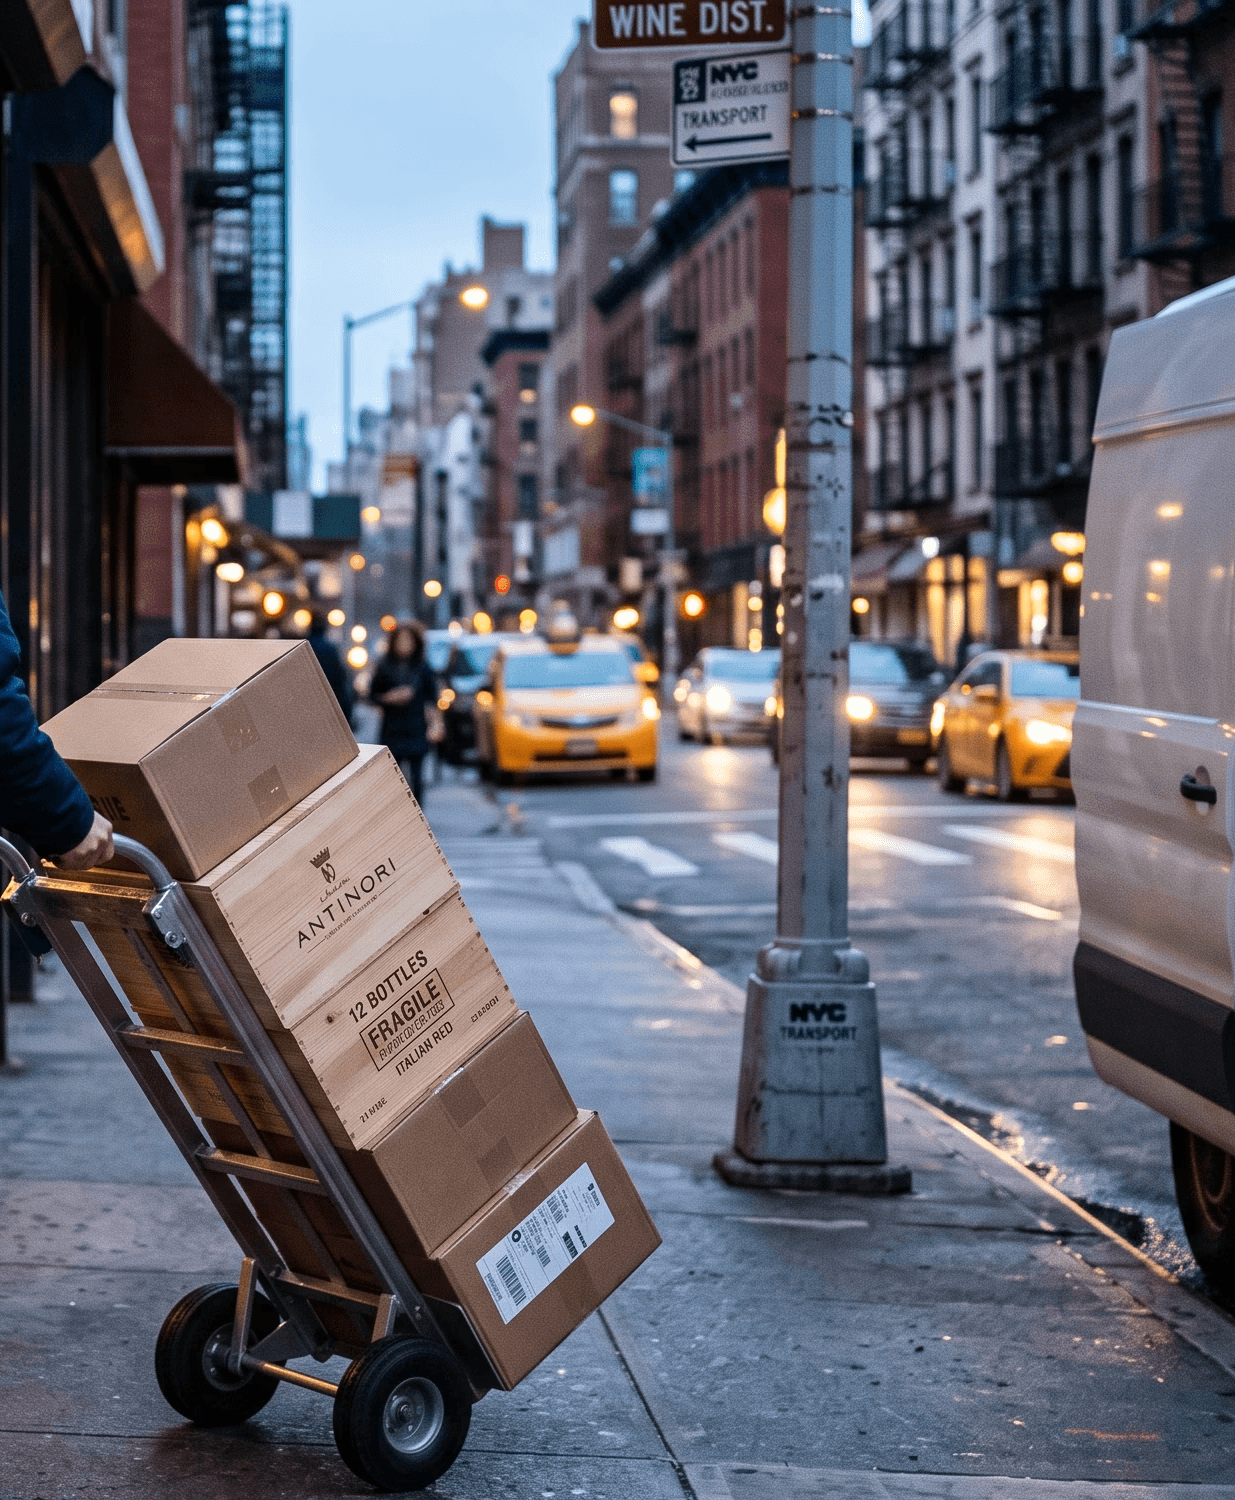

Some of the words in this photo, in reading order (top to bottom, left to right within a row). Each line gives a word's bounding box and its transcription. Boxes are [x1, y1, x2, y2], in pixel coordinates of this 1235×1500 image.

[609, 3, 687, 38] WINE
[699, 0, 774, 34] DIST.
[710, 61, 758, 84] NYC
[681, 104, 768, 130] TRANSPORT
[298, 857, 396, 949] ANTINORI
[349, 1001, 368, 1024] 12
[365, 950, 428, 1010] BOTTLES
[367, 978, 441, 1050] FRAGILE
[789, 1002, 846, 1023] NYC
[395, 1037, 434, 1076] ITALIAN
[434, 1021, 454, 1046] RED
[779, 1025, 857, 1041] TRANSPORT
